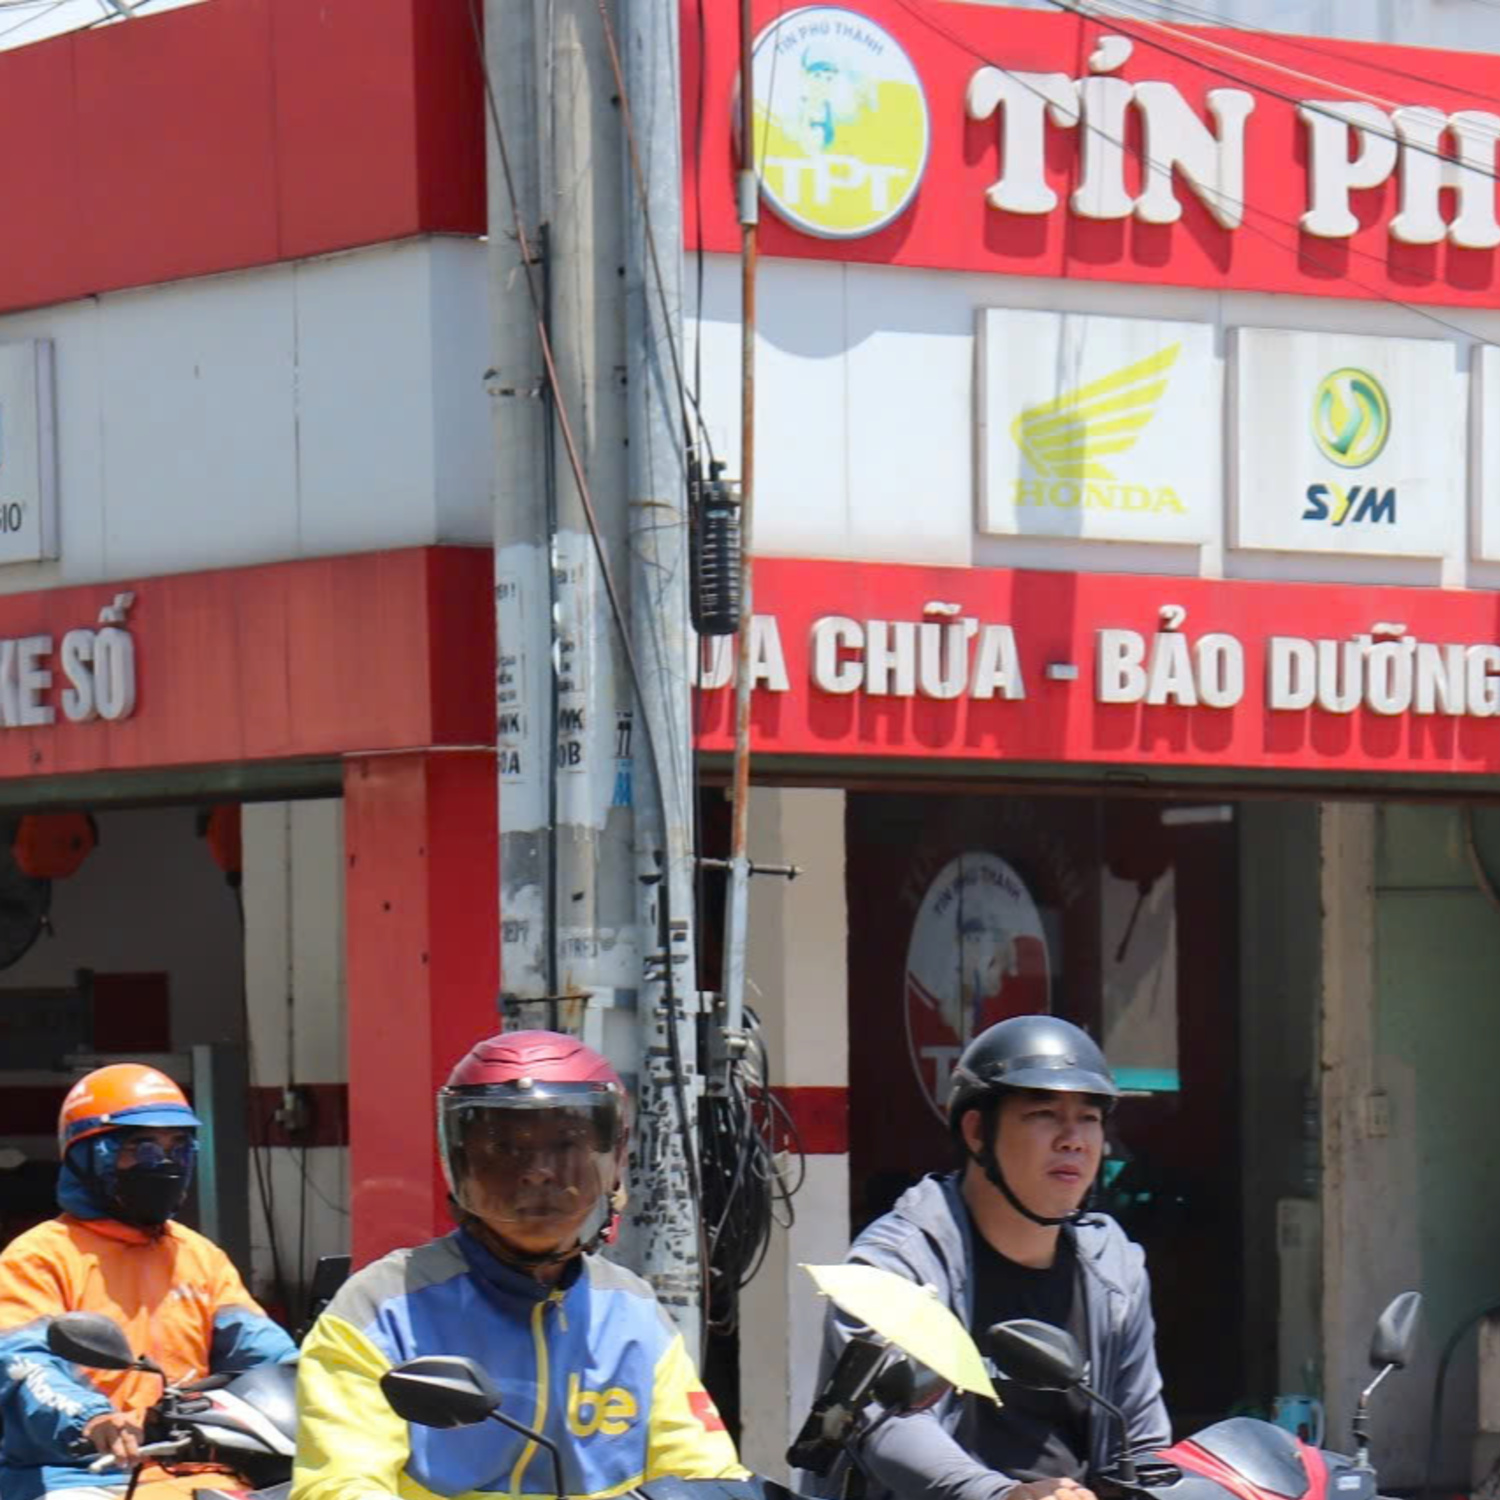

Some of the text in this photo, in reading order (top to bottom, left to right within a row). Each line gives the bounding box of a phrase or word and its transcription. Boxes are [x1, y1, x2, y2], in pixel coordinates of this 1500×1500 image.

[967, 35, 1256, 230] TÍN
[765, 154, 909, 212] TPT
[1010, 477, 1188, 515] HONDA
[1301, 482, 1398, 527] SYM
[60, 590, 137, 722] SỐ
[810, 600, 1026, 701] CHỮA
[1094, 603, 1245, 711] BẢO
[566, 1372, 638, 1438] be
